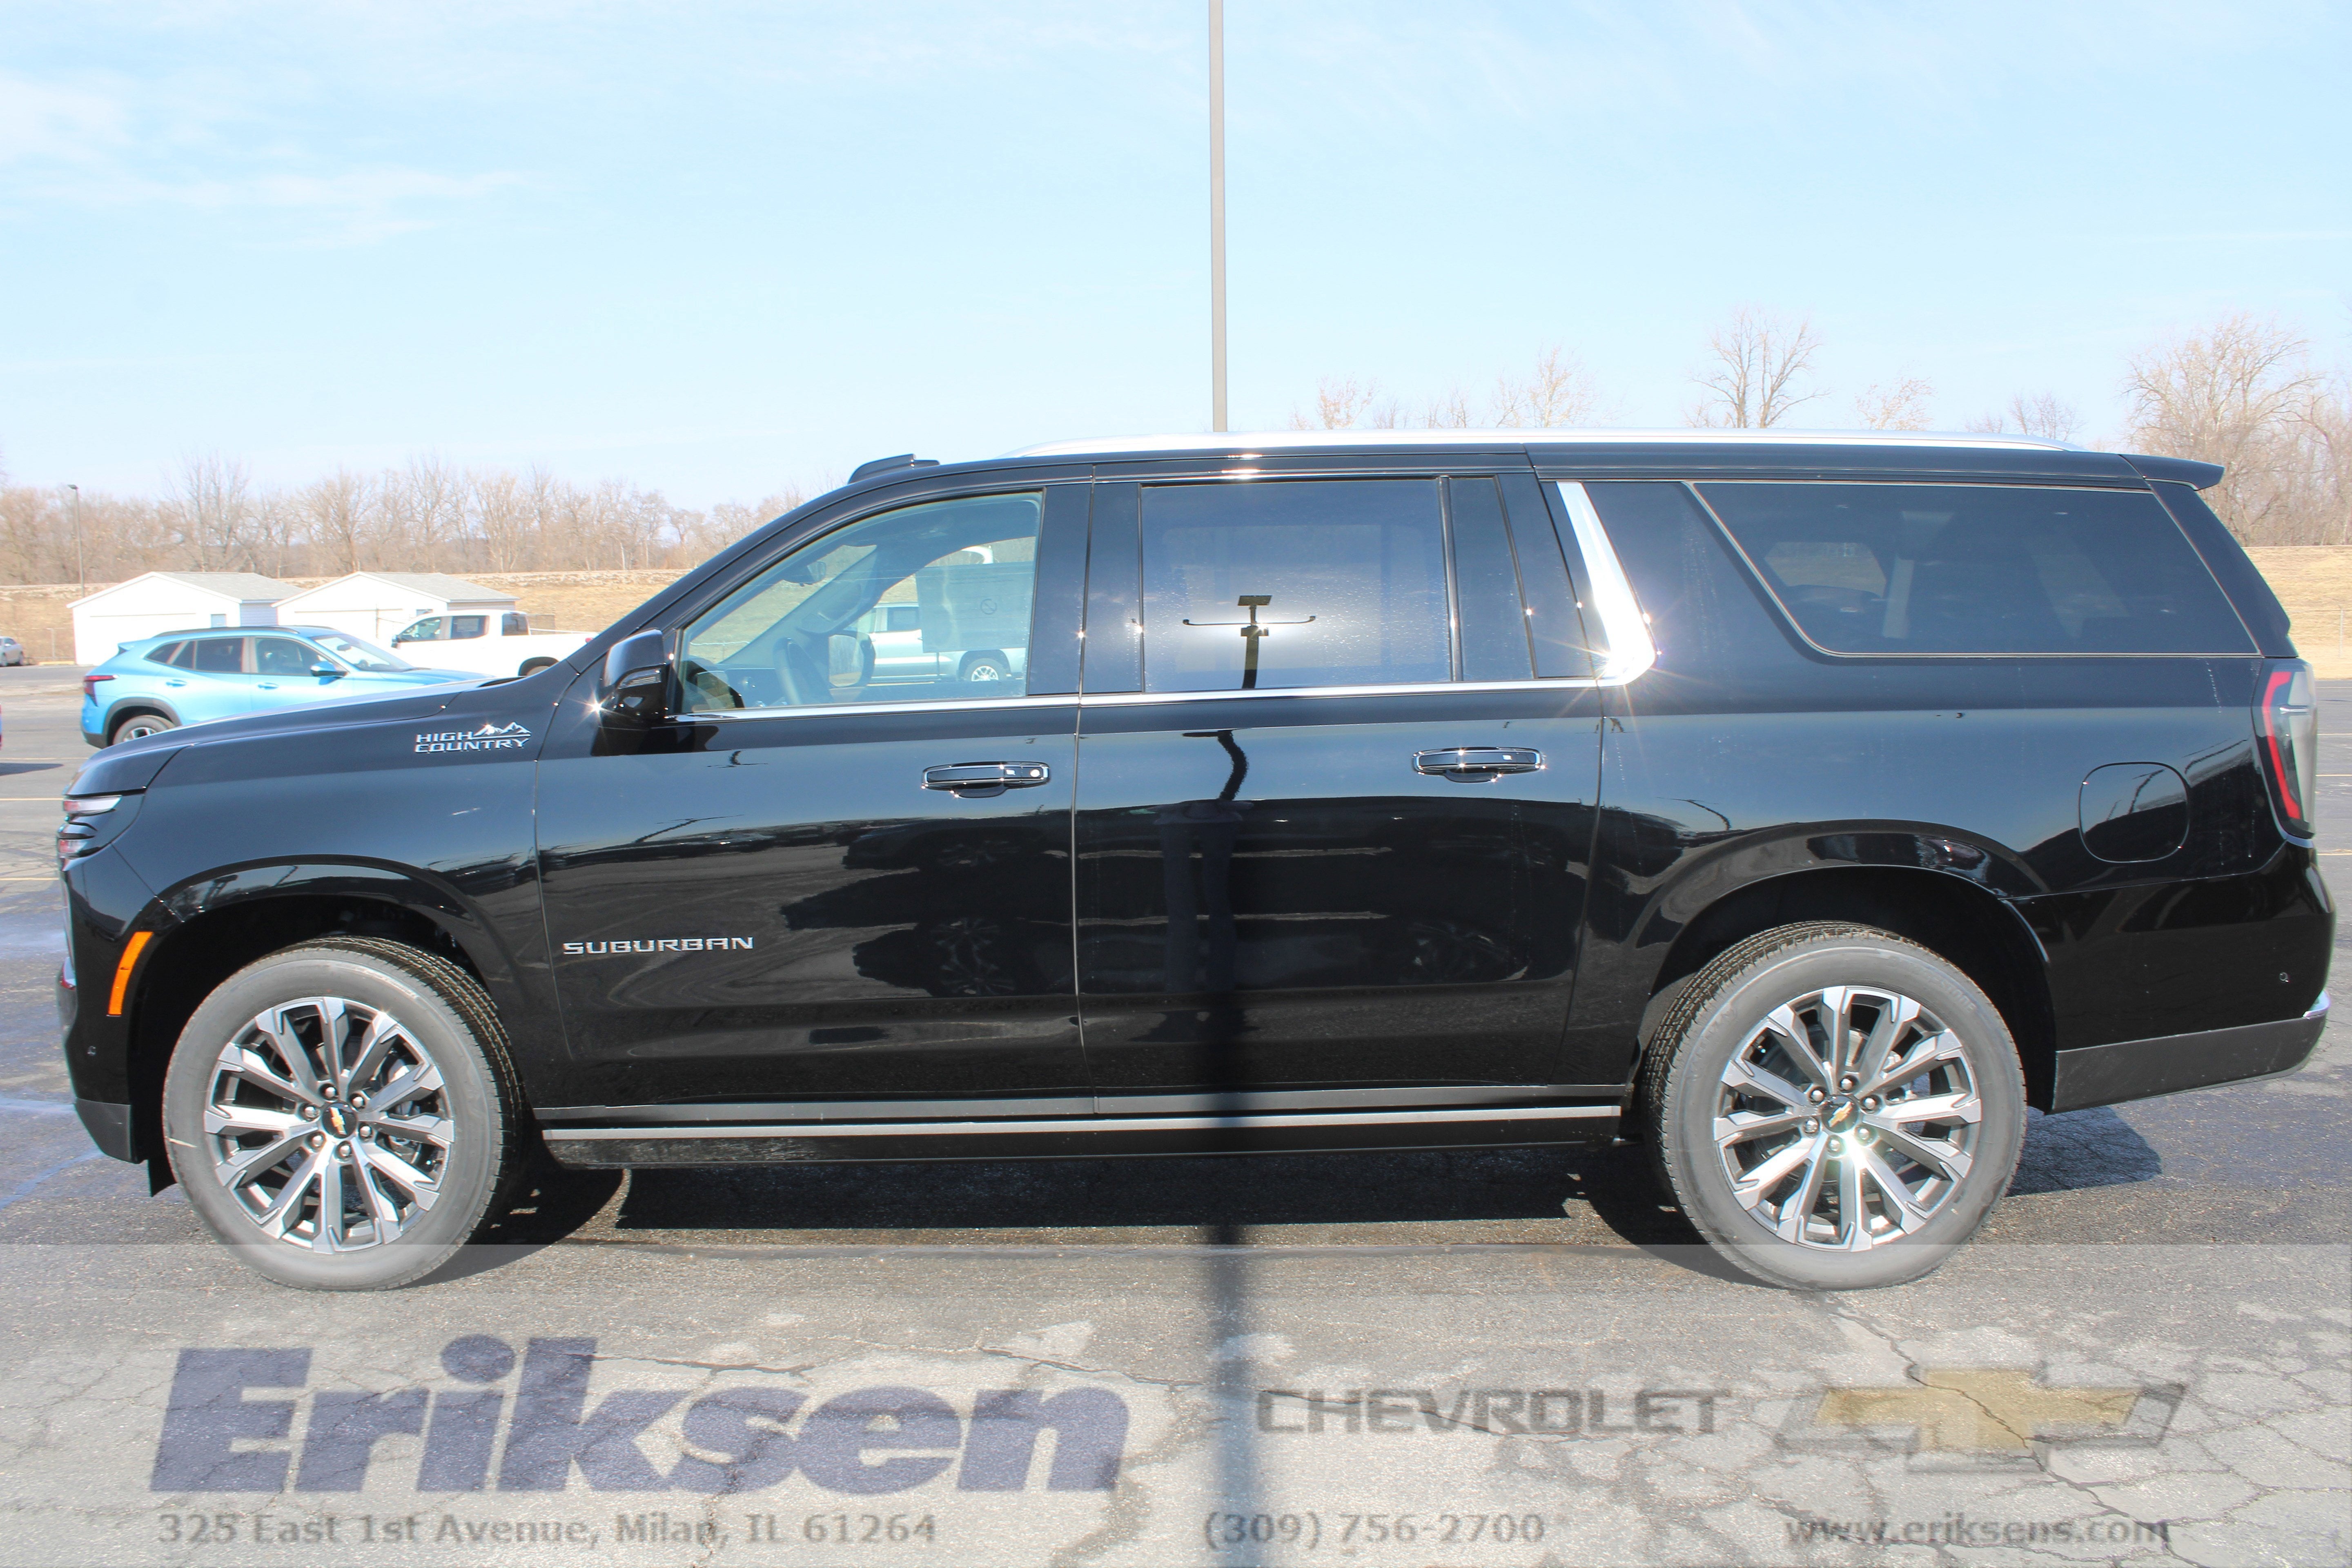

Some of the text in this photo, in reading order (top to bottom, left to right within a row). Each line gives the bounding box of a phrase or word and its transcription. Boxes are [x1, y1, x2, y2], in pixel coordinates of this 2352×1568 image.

[414, 737, 530, 753] COUNTRY
[415, 731, 474, 743] HIGH
[562, 937, 754, 955] SUBURBAN
